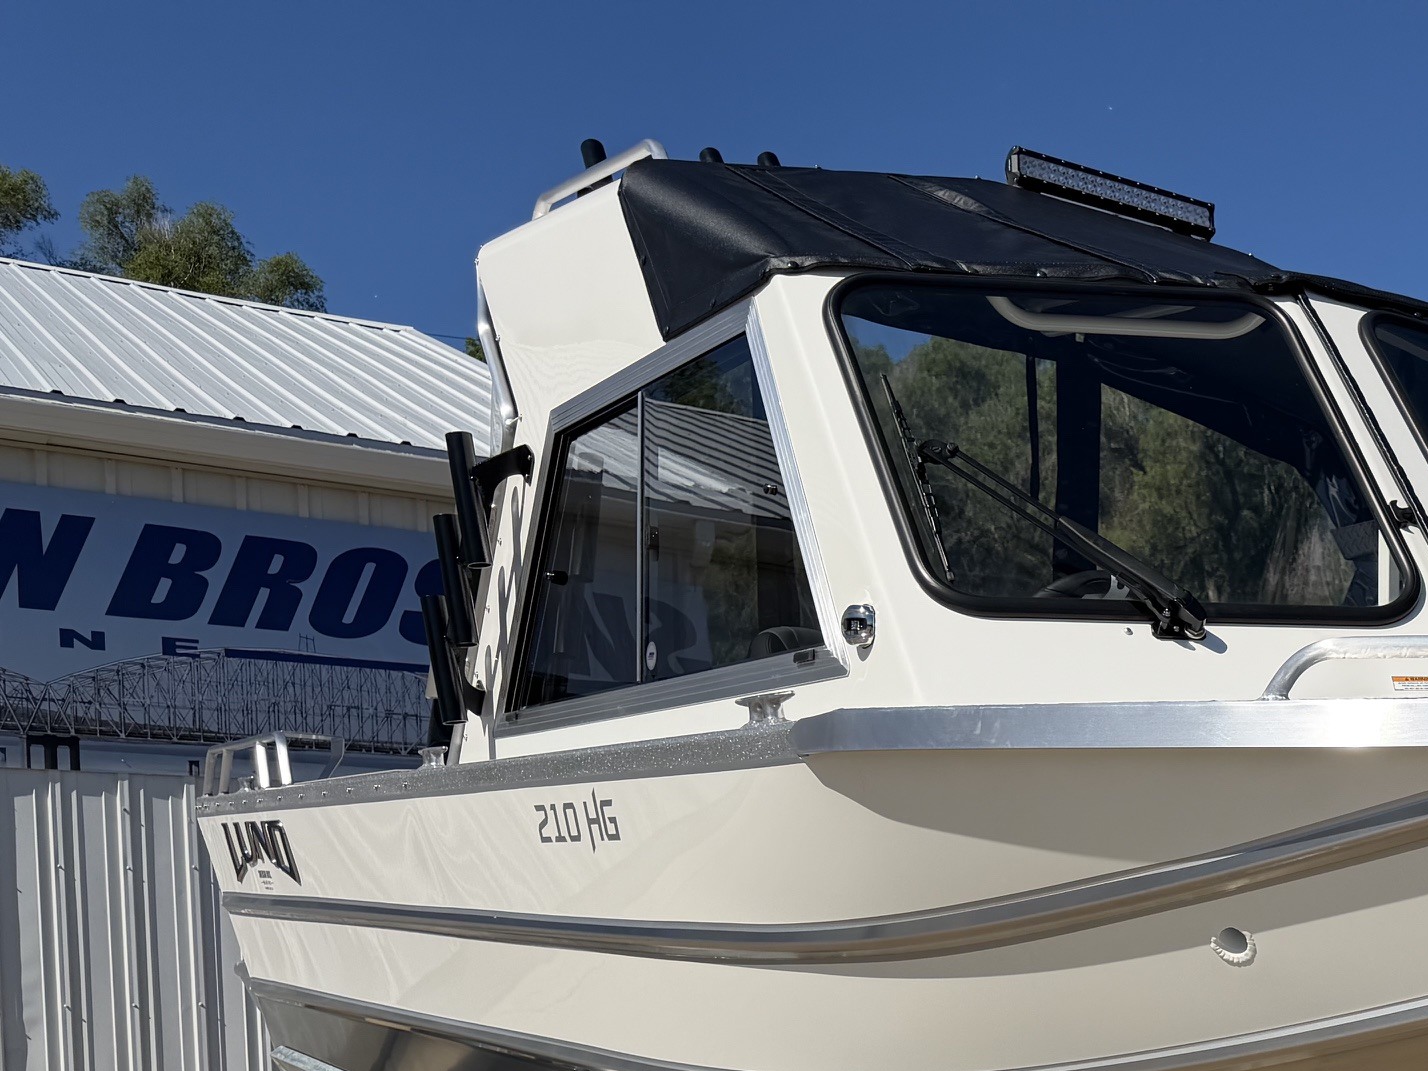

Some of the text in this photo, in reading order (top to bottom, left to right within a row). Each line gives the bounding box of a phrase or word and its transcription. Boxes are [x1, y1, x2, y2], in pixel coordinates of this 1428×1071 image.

[221, 819, 302, 887] LUND
[533, 786, 622, 854] 210 HG
